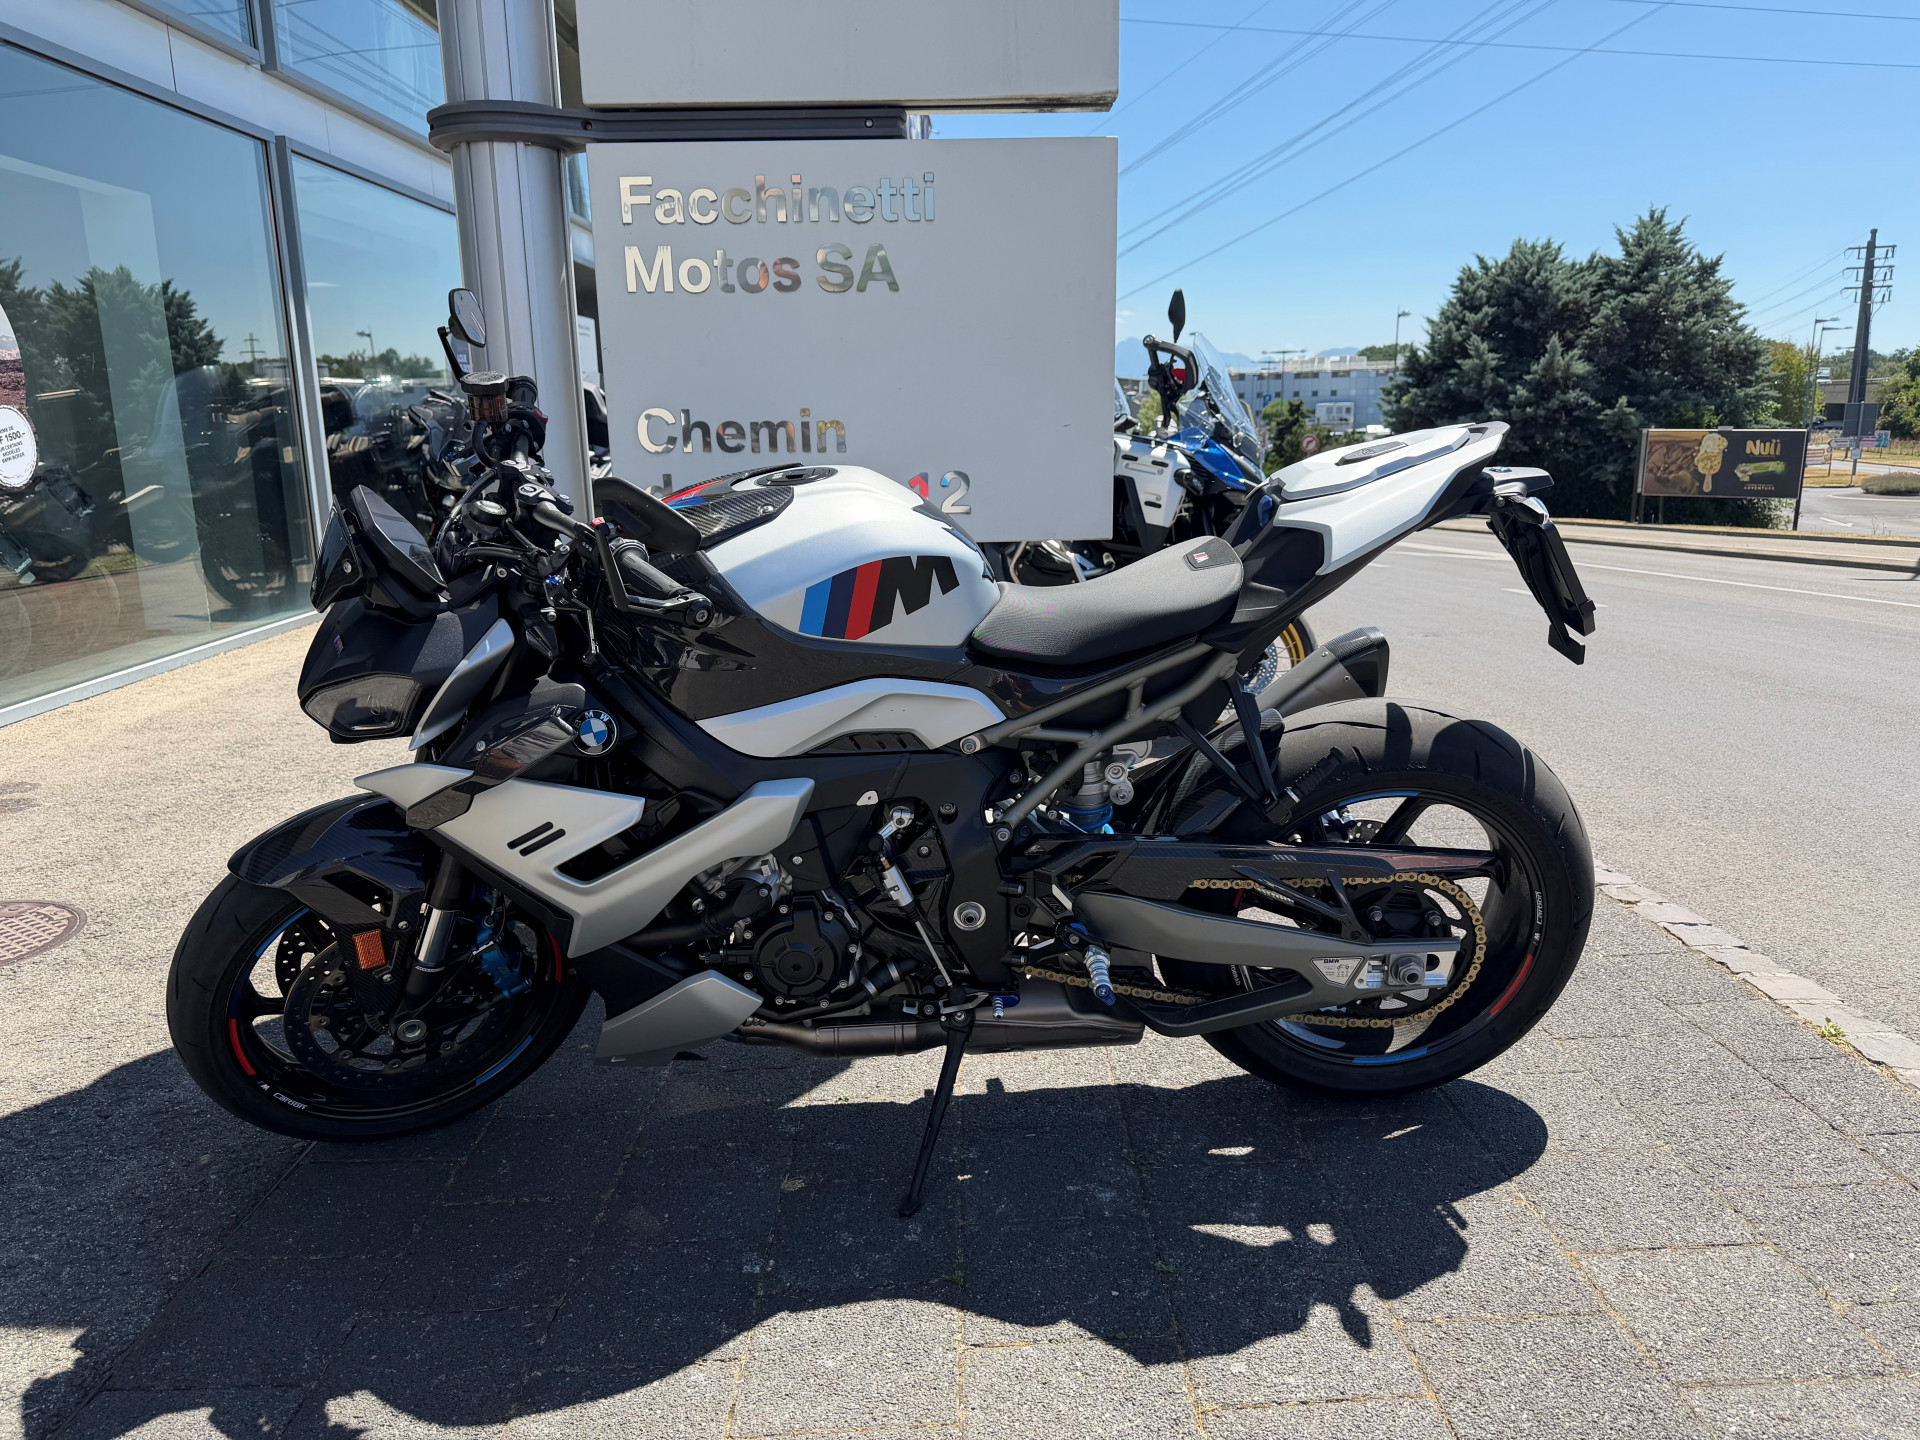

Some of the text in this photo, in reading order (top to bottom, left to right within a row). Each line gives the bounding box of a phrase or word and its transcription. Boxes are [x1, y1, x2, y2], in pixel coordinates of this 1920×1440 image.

[619, 172, 935, 225] Facchinetti
[624, 243, 900, 294] Motos SA
[637, 407, 847, 454] Chemin
[572, 711, 611, 729] BMW
